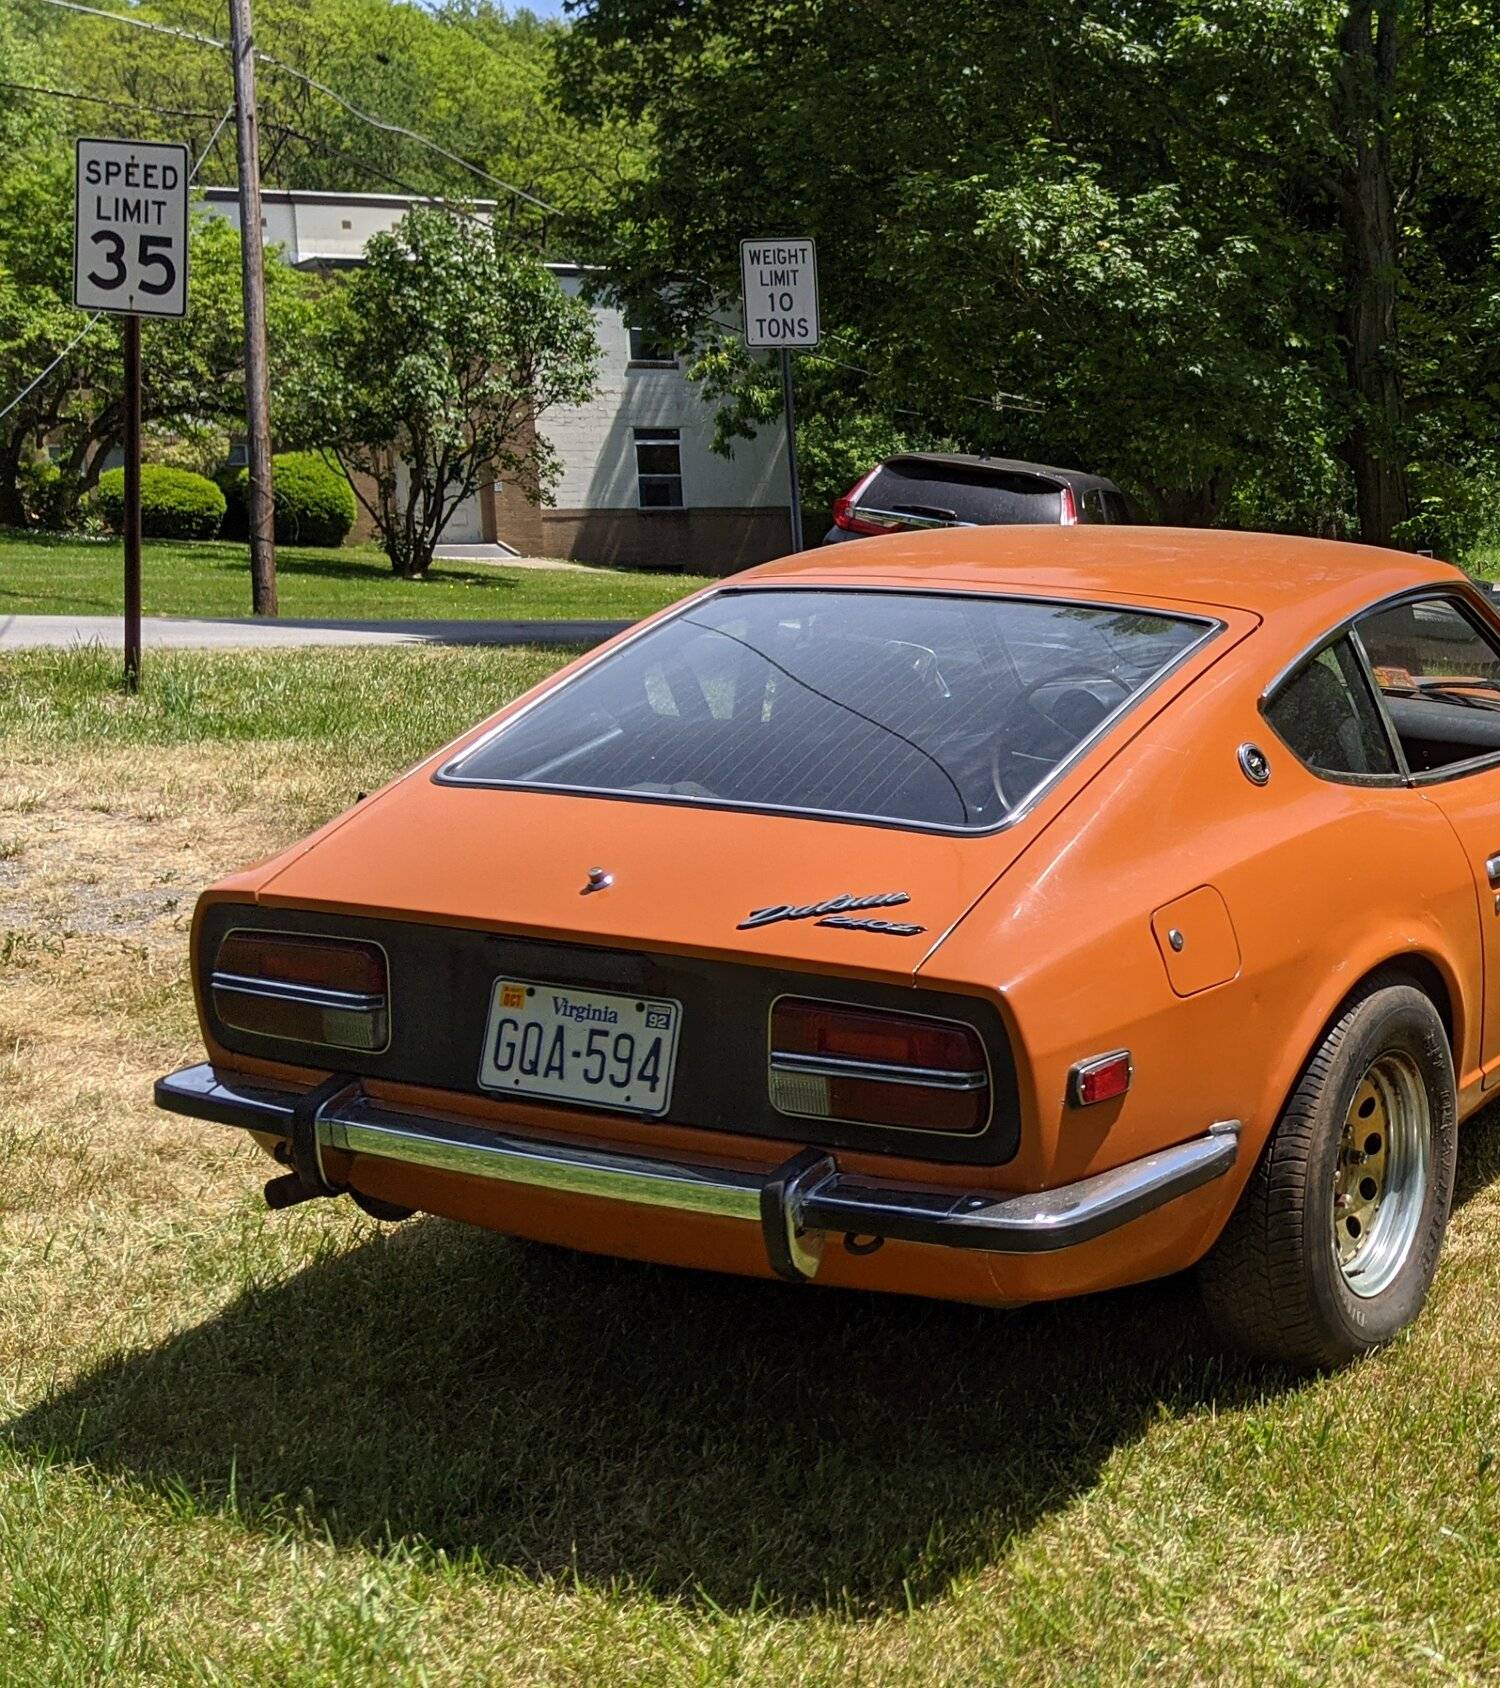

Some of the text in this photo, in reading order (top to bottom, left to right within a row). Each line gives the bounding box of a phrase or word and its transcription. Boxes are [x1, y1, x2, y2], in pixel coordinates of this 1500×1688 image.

[85, 160, 178, 190] SPEED
[96, 195, 167, 225] LIMIT
[87, 230, 176, 295] 35
[748, 248, 808, 266] WEIGHT
[760, 269, 800, 287] LIMIT
[768, 292, 793, 312] 10
[755, 317, 809, 339] TONS
[552, 996, 618, 1023] Virginia
[649, 1014, 667, 1028] 92
[494, 1018, 662, 1093] GQA-594
